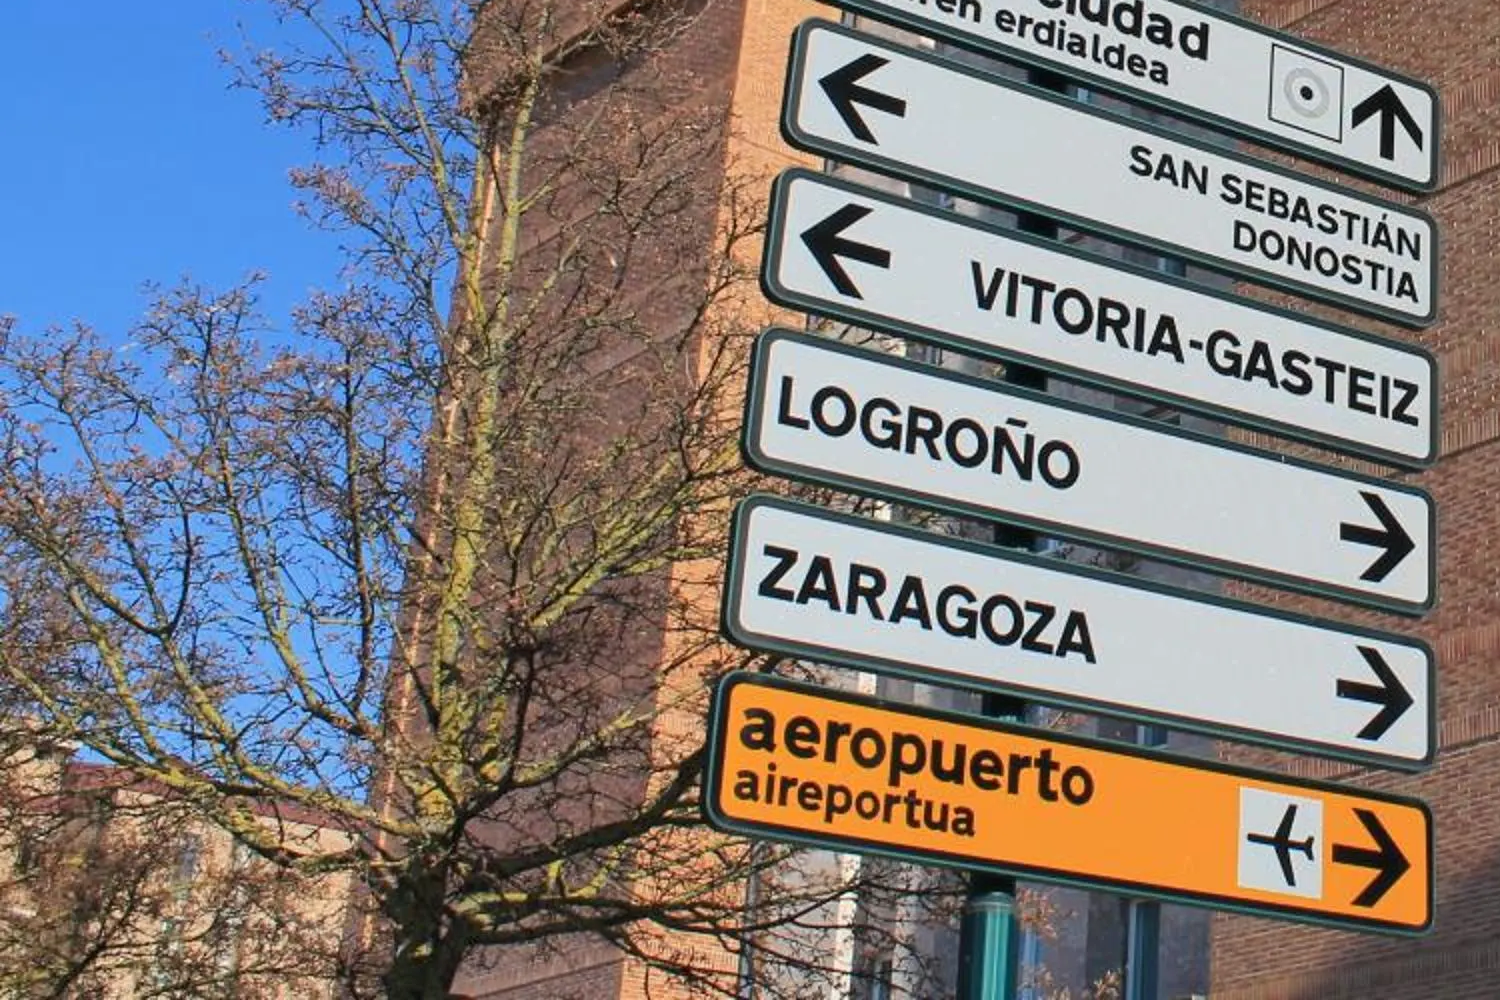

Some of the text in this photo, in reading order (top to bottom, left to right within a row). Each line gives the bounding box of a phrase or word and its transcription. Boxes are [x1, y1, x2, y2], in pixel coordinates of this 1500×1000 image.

[995, 4, 1169, 86] erdialdea
[1129, 145, 1421, 261] SAN SEBASTIÁN
[1233, 219, 1419, 303] DONOSTIA
[970, 260, 1419, 427] VITORIA-GASTEIZ
[777, 375, 1081, 490] LOGROÑO
[757, 544, 1097, 664] ZARAGOZA
[733, 763, 976, 837] aireportua
[739, 706, 1095, 805] aeropuerto
